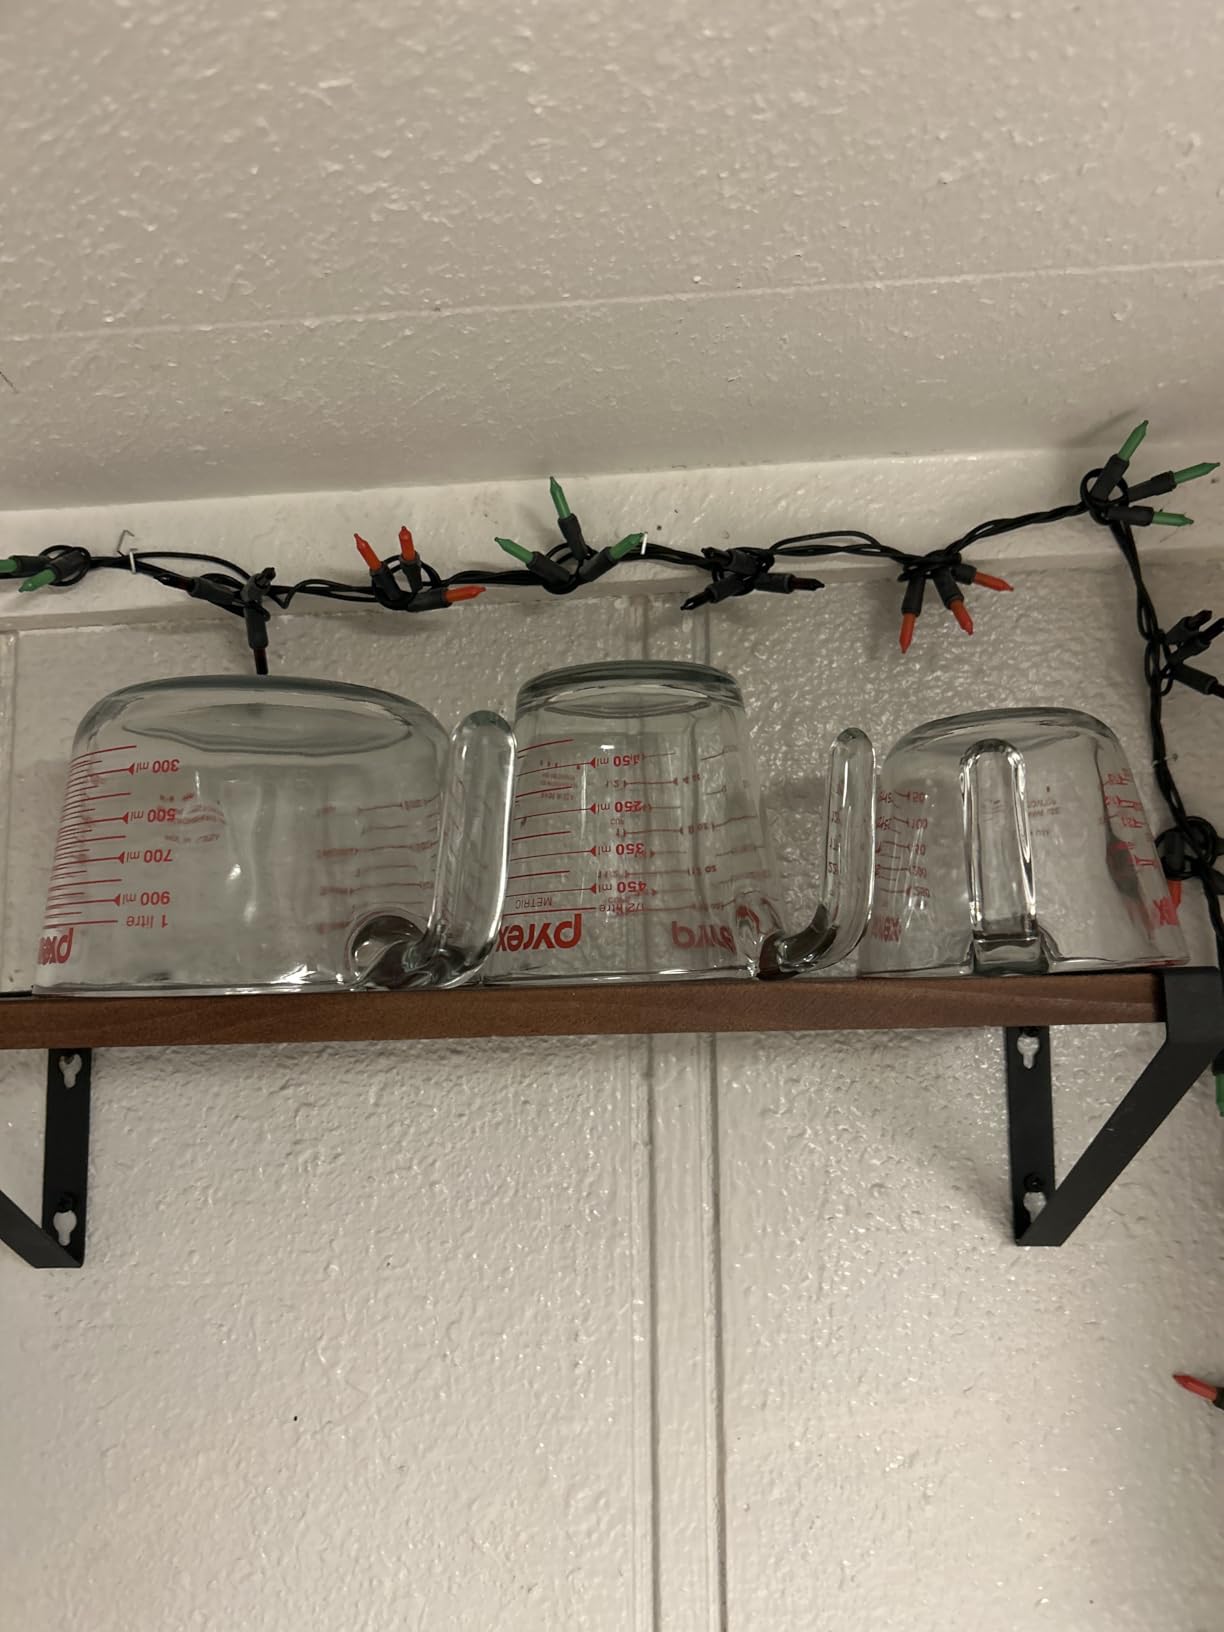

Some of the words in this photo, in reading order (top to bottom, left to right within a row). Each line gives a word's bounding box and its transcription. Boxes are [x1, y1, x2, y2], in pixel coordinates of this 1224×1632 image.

[136, 762, 149, 773] ml
[152, 759, 180, 773] 300
[597, 757, 609, 767] ml
[598, 803, 610, 813] ml
[615, 801, 643, 813] 250
[131, 812, 144, 822] ml
[147, 808, 176, 823] 500
[598, 845, 611, 854] ml
[616, 843, 645, 855] 350
[126, 852, 140, 862] ml
[144, 849, 173, 863] 700
[598, 883, 612, 892] ml
[617, 882, 647, 893] 450
[122, 894, 136, 904] ml
[140, 891, 170, 906] 900
[515, 897, 552, 909] METRIC
[126, 915, 153, 928] litre
[161, 915, 168, 928] 1
[496, 913, 582, 952] pyrex
